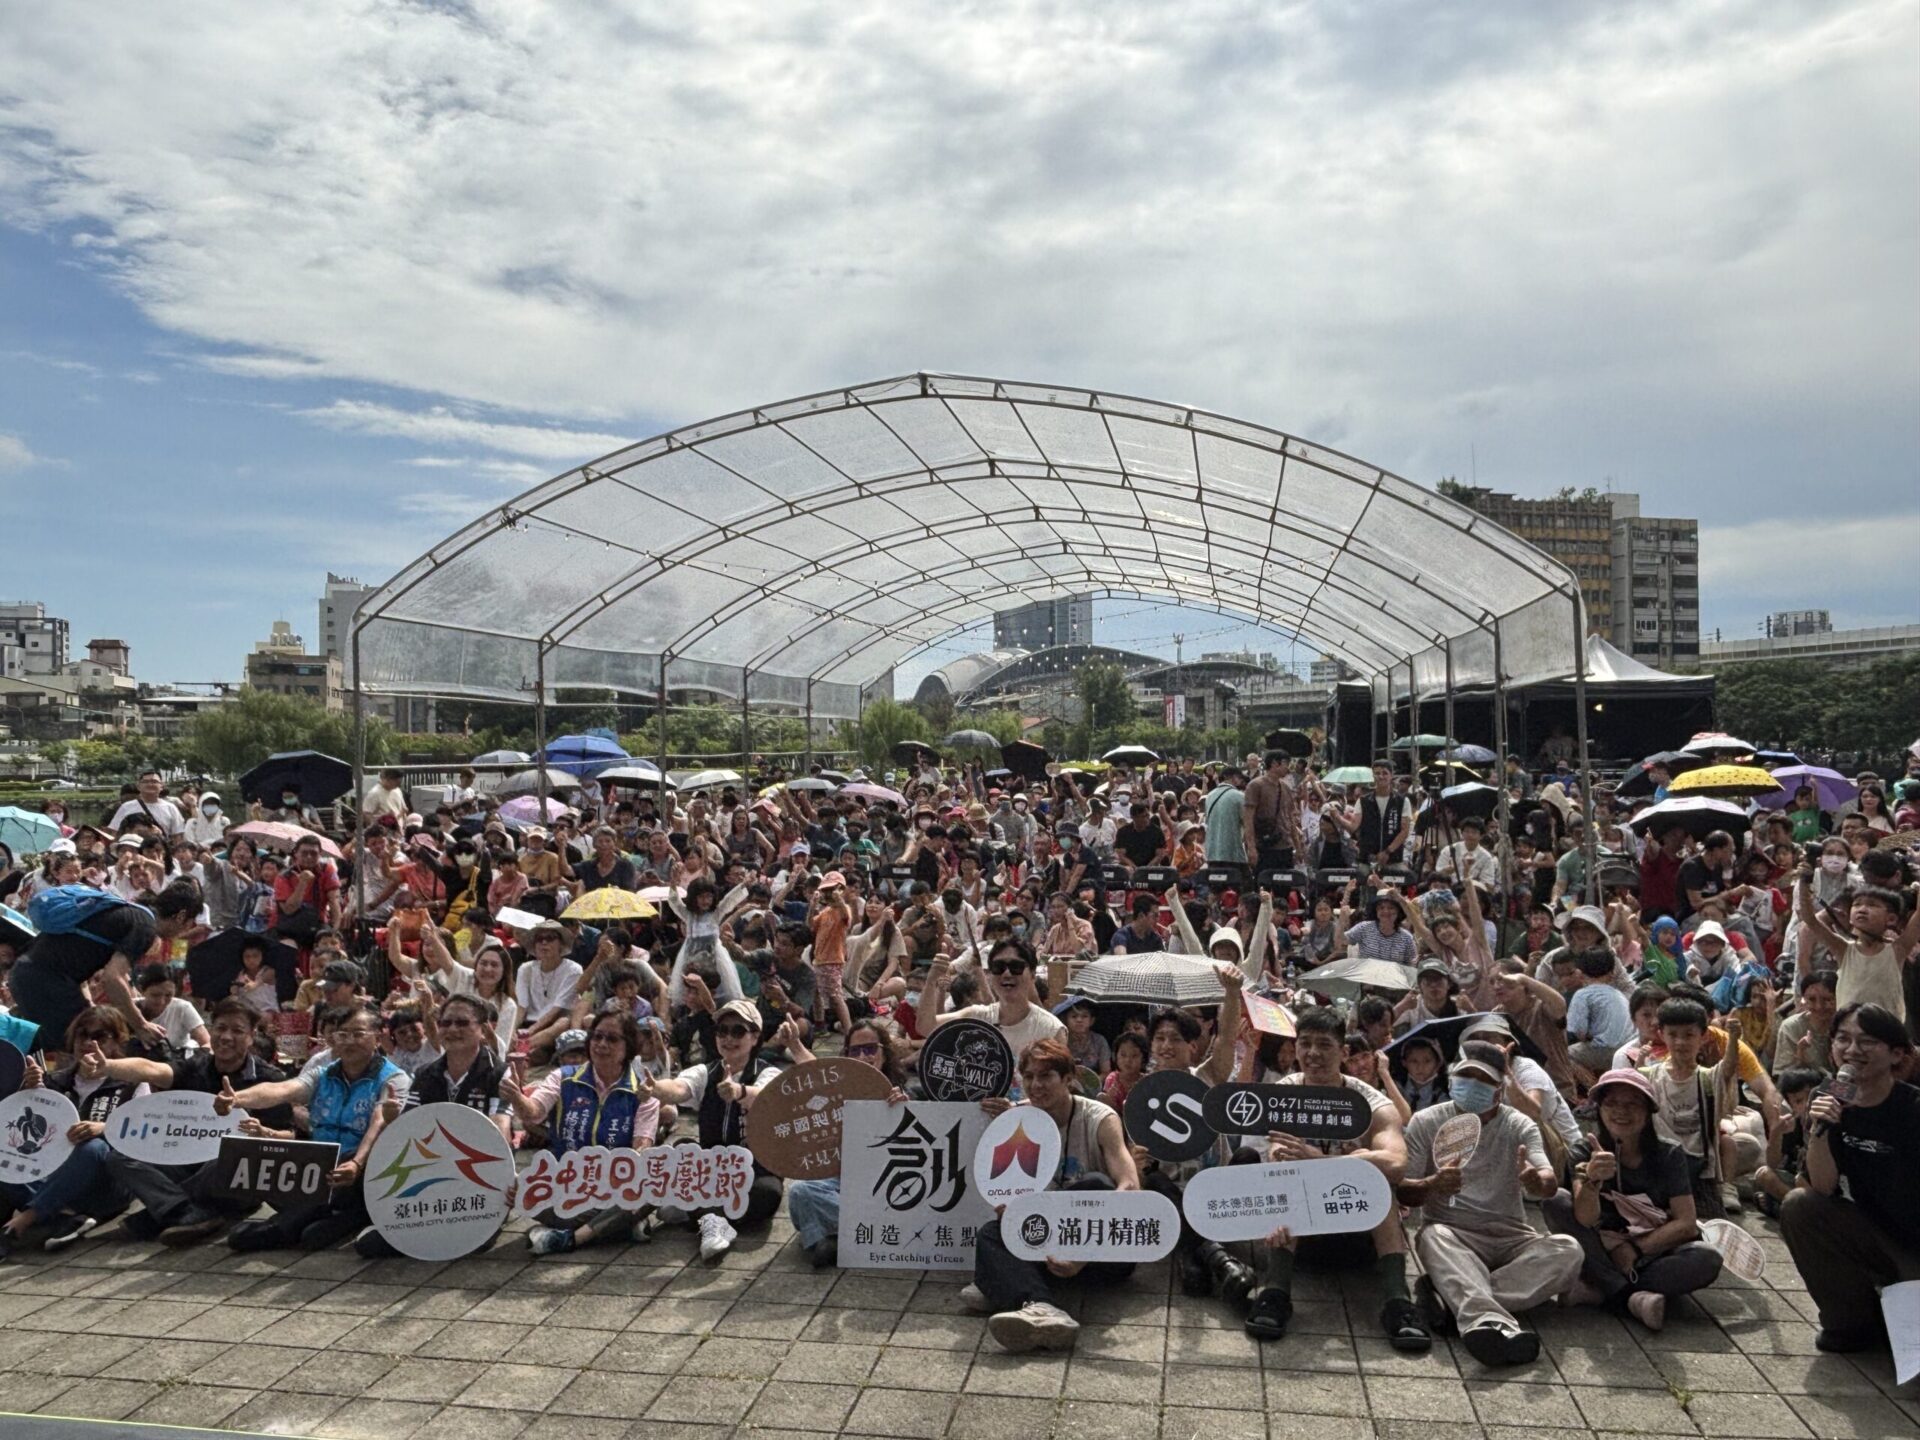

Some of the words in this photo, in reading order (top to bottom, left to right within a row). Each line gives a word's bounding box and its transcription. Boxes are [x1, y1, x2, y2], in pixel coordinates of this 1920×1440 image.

[781, 1073, 814, 1095] 6.14
[820, 1065, 839, 1085] 15
[965, 1067, 993, 1088] WALK
[165, 1123, 232, 1140] LaLaport
[230, 1157, 321, 1194] AECO
[1208, 1209, 1238, 1219] TALMUD
[1239, 1208, 1263, 1217] HOTEL
[1264, 1206, 1290, 1216] GROUP
[1324, 1199, 1369, 1215] 田中央
[855, 1222, 901, 1246] 創造
[1057, 1217, 1161, 1246] 滿月精釀
[869, 1252, 886, 1263] Eye
[889, 1252, 931, 1264] Catching
